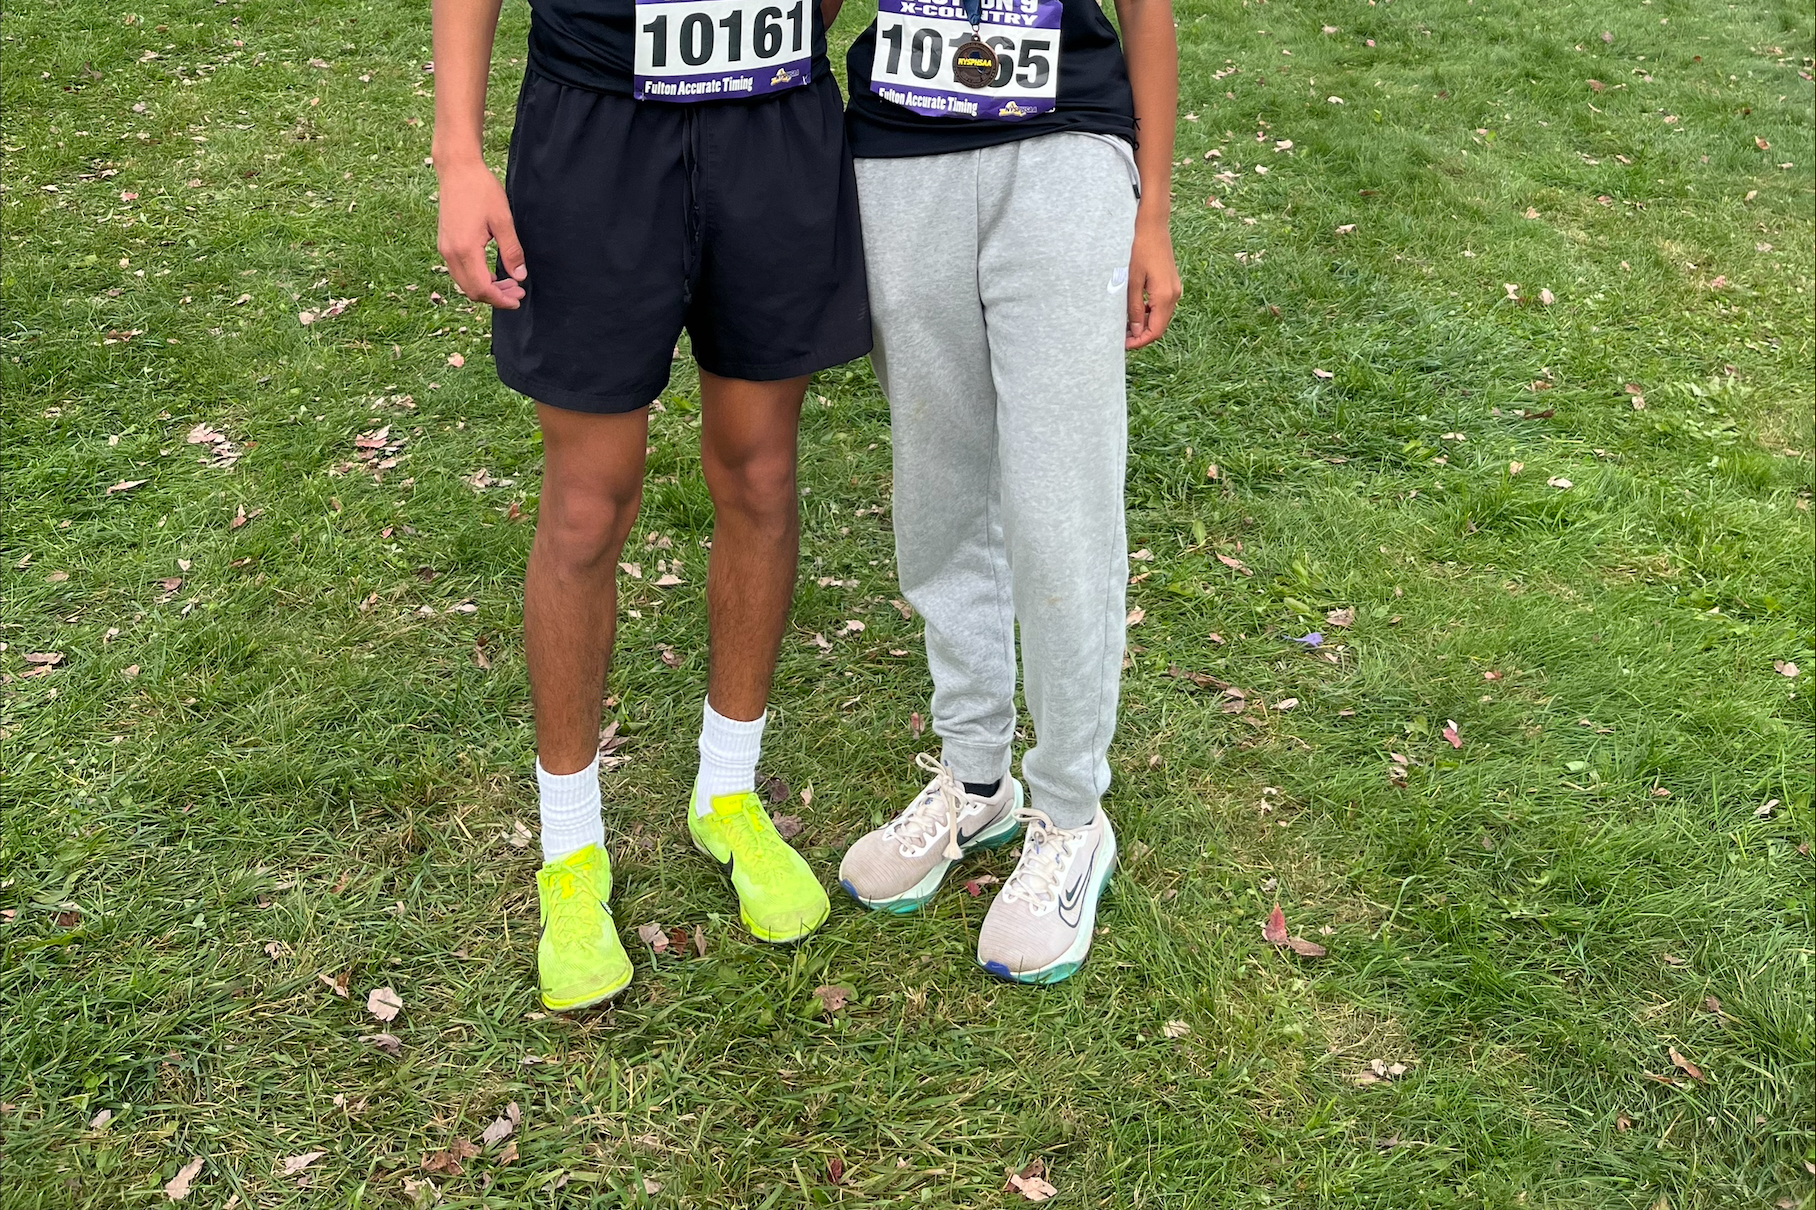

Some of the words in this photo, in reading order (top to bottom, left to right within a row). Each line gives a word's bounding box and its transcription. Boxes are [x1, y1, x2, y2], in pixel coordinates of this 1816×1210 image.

[642, 0, 804, 68] 10161
[644, 80, 677, 96] Fulton
[677, 78, 721, 96] Accurate
[722, 74, 754, 92] Timing
[878, 87, 906, 105] Fulton
[905, 91, 946, 110] Accurate
[947, 96, 978, 117] Timing
